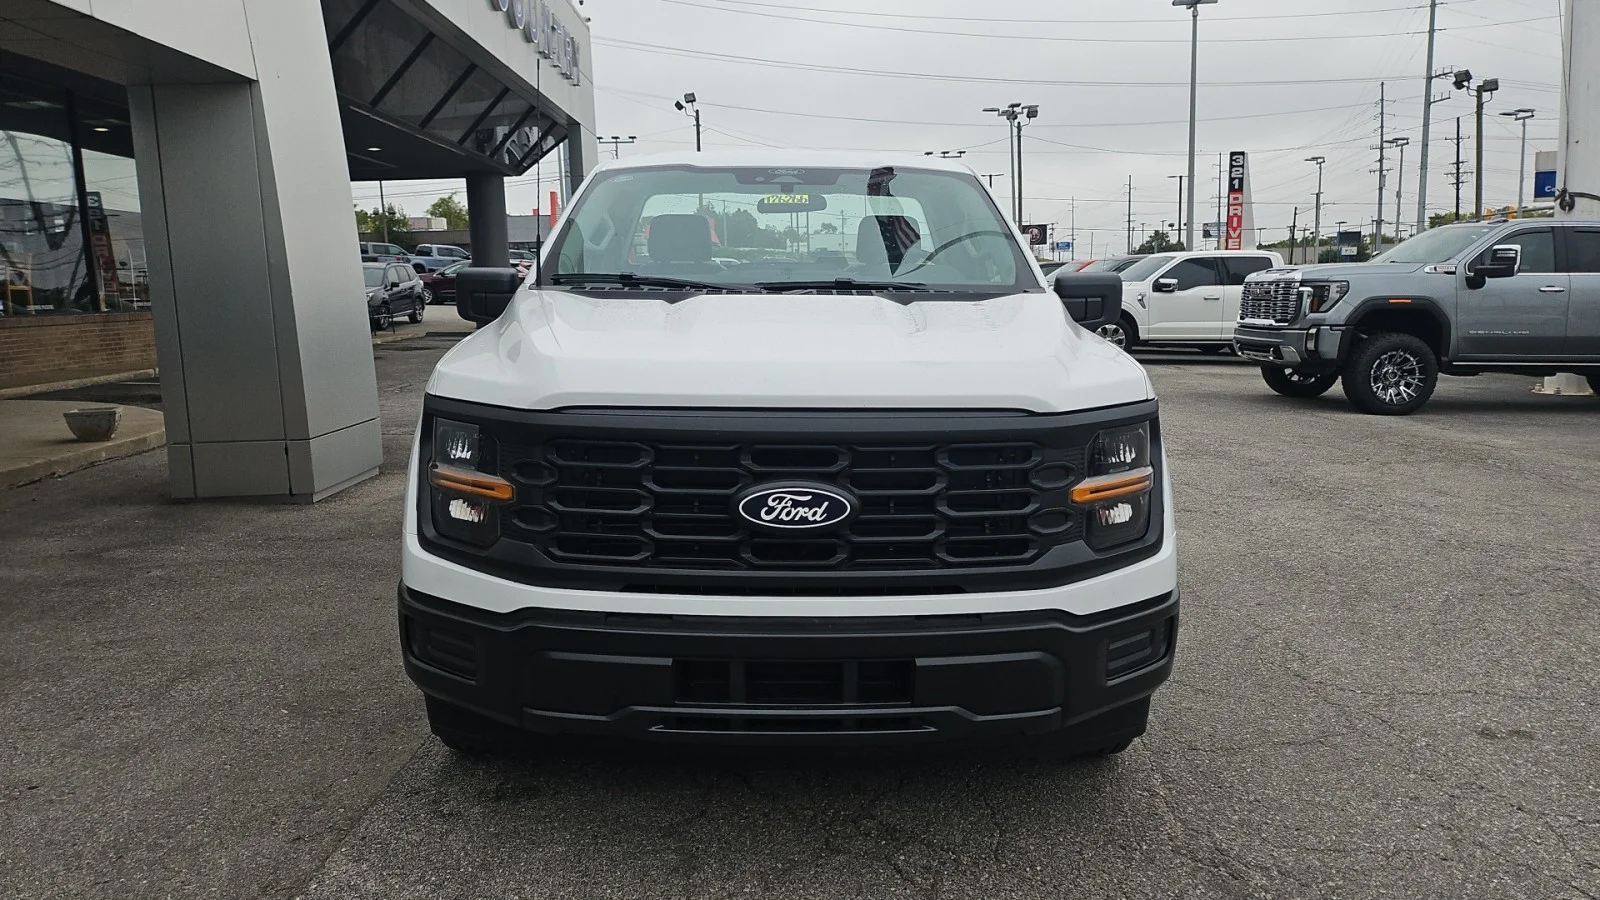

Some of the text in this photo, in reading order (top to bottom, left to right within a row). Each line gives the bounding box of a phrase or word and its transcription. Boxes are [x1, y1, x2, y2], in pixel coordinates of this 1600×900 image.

[1227, 155, 1244, 249] 321 DRIVE
[760, 493, 829, 521] Ford
